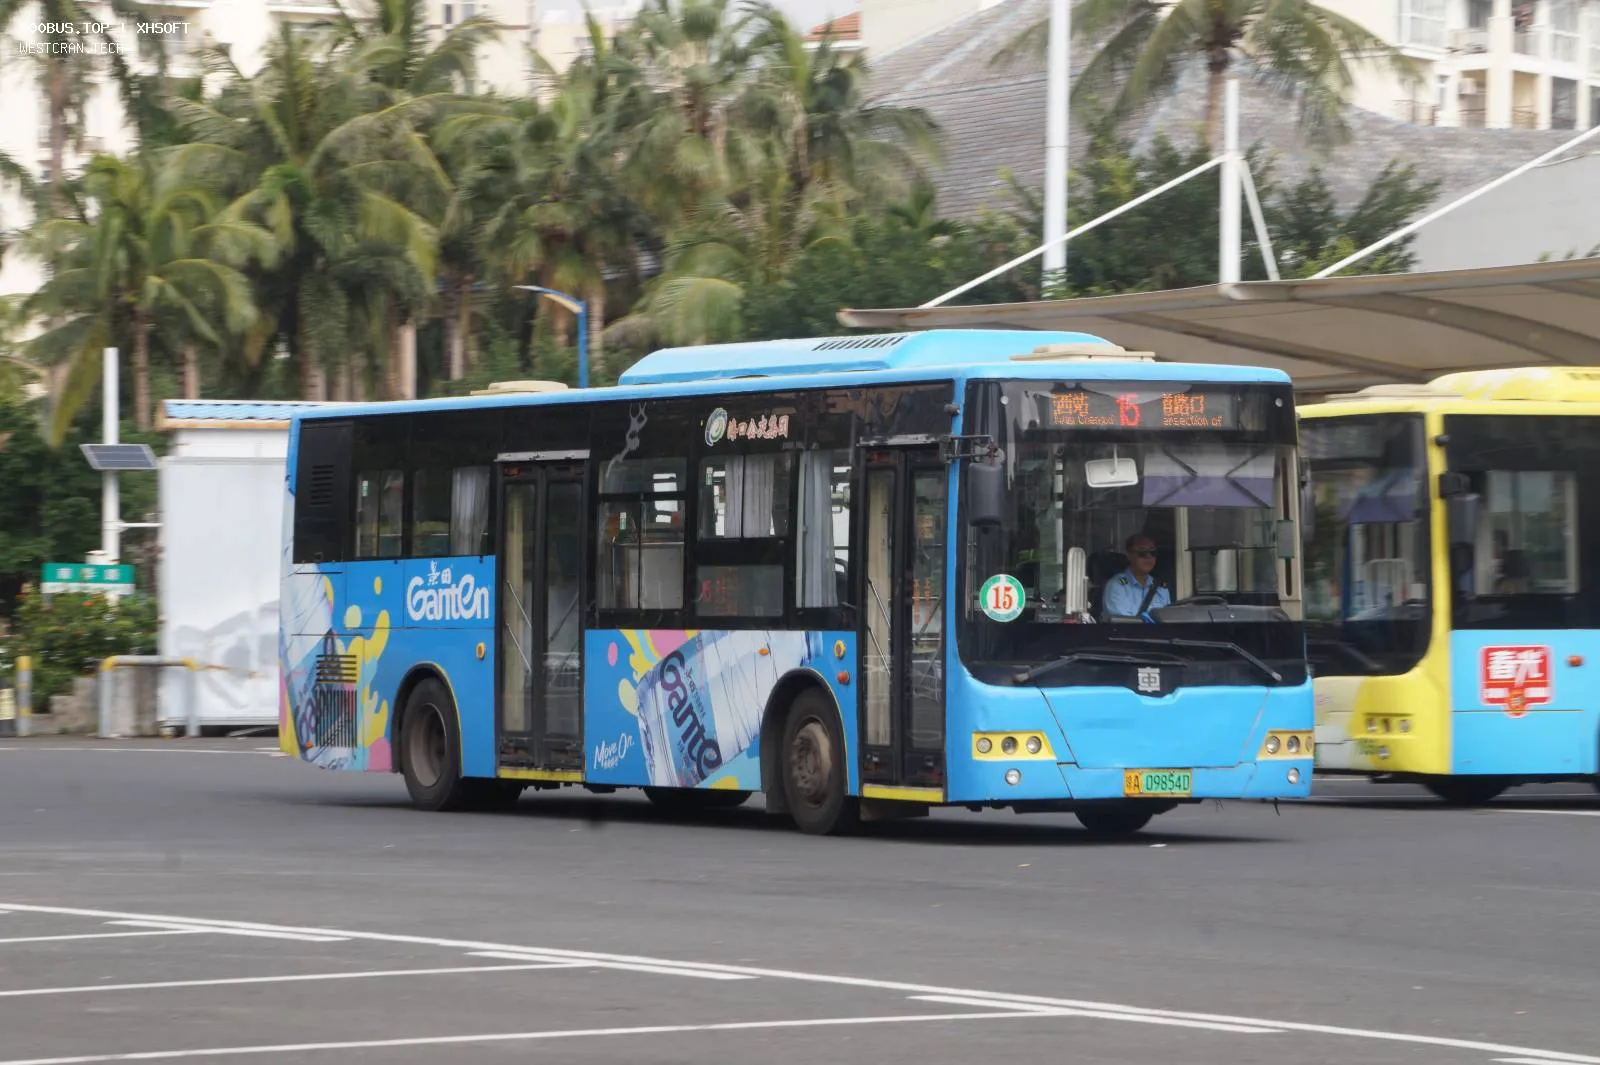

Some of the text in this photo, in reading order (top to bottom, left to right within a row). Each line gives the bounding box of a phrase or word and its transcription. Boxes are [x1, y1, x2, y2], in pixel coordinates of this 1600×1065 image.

[1116, 393, 1141, 427] 15
[727, 414, 790, 441] 海口公交集团
[428, 559, 452, 586] 景田
[406, 573, 490, 622] Ganten
[992, 586, 1013, 610] 15
